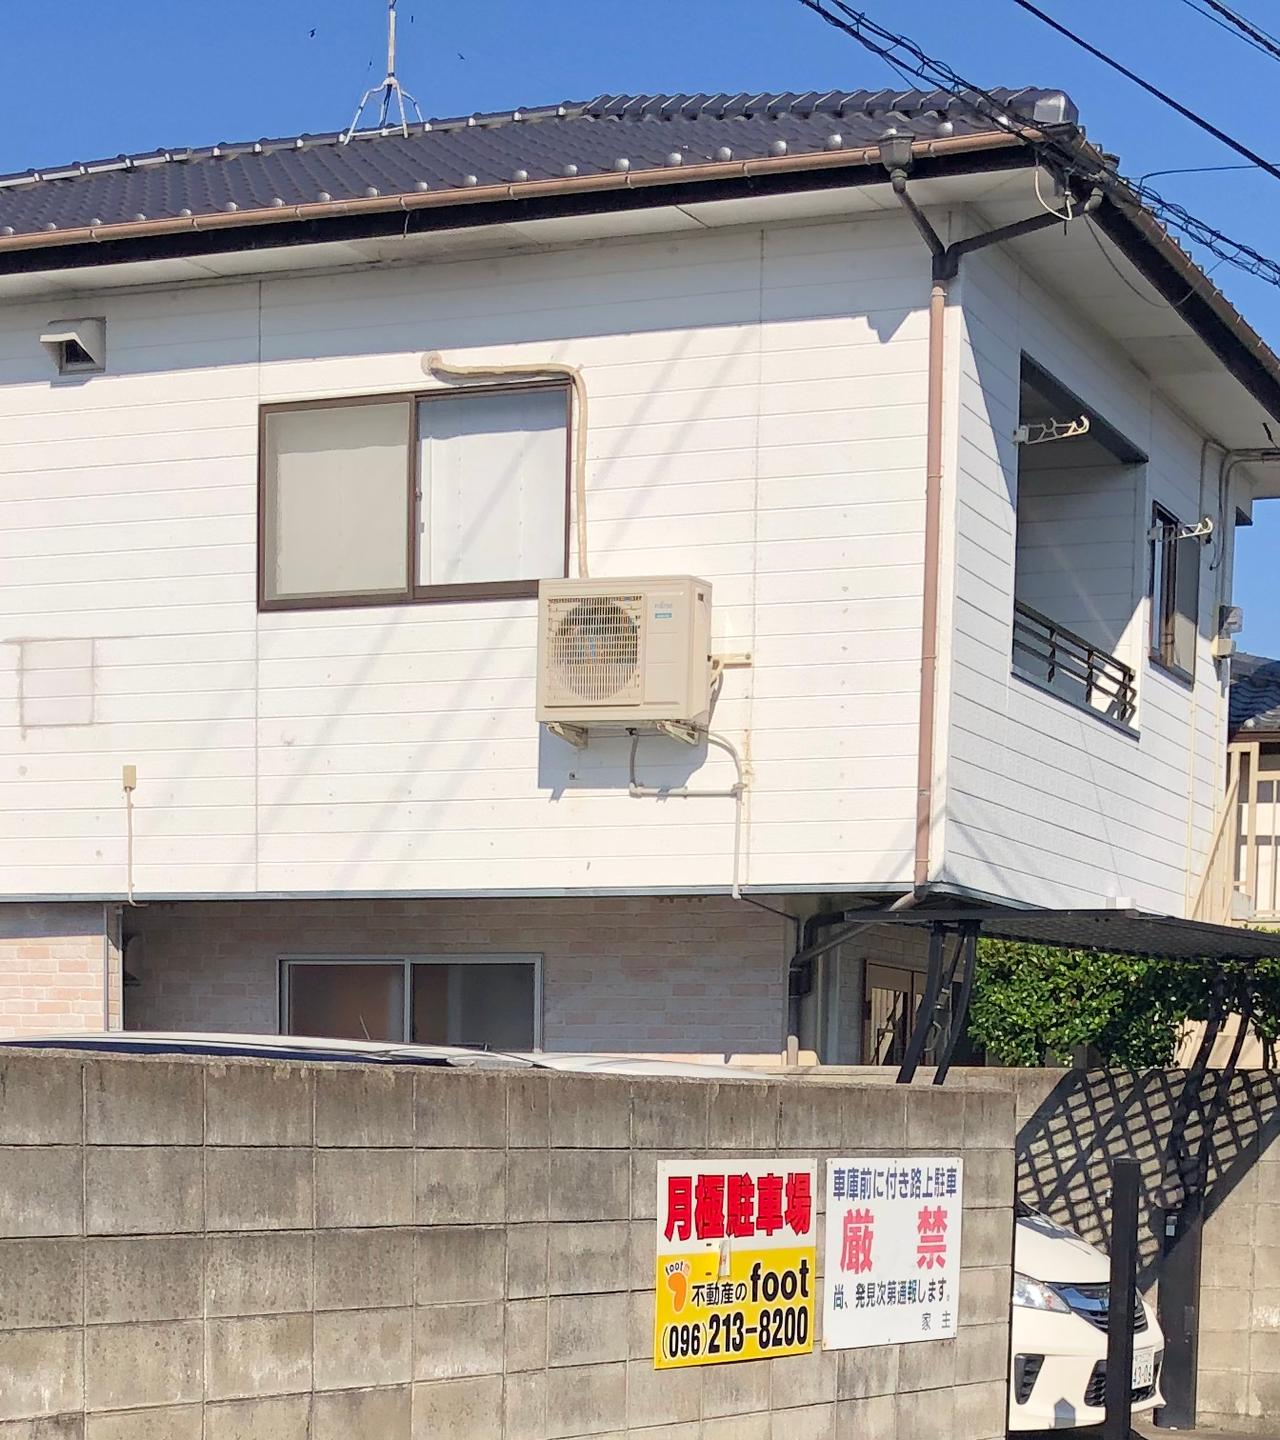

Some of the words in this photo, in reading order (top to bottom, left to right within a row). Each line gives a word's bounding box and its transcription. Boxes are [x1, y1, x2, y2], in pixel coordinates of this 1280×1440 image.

[833, 1167, 957, 1201] 車庫前に付き路上駐車
[664, 1172, 811, 1242] 月極駐車場
[750, 1259, 809, 1303] foot
[833, 1278, 951, 1310] 尚、発見次第通報します。
